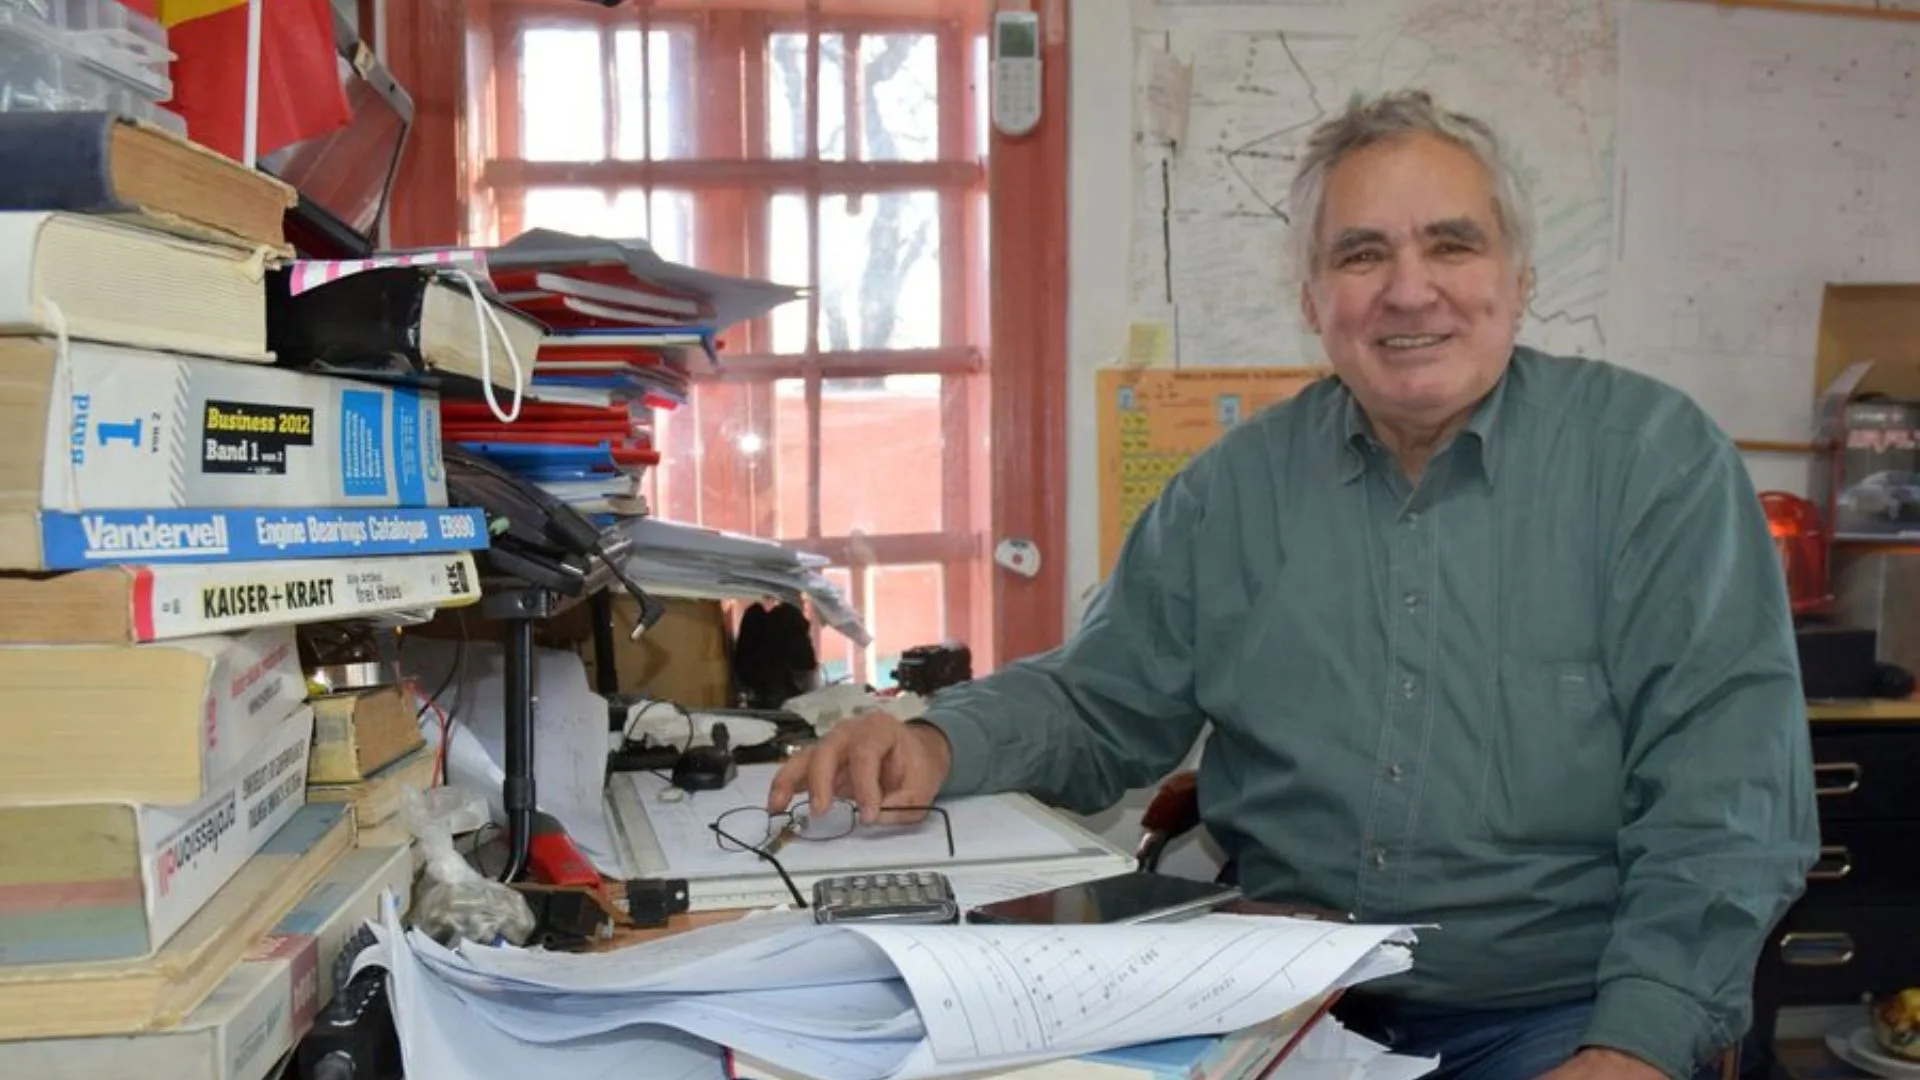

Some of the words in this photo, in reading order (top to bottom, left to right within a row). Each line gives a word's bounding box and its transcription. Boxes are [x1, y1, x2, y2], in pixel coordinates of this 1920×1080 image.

[70, 393, 90, 465] Band
[97, 417, 142, 448] 1
[207, 406, 277, 433] Business
[278, 413, 311, 435] 2012
[205, 438, 249, 462] Band
[250, 441, 260, 462] 1
[81, 514, 229, 550] Vandervell
[255, 515, 307, 550] Engine
[307, 515, 368, 546] Bearings
[368, 514, 429, 544] Catalogue
[203, 578, 335, 619] KAISER+KRAFT
